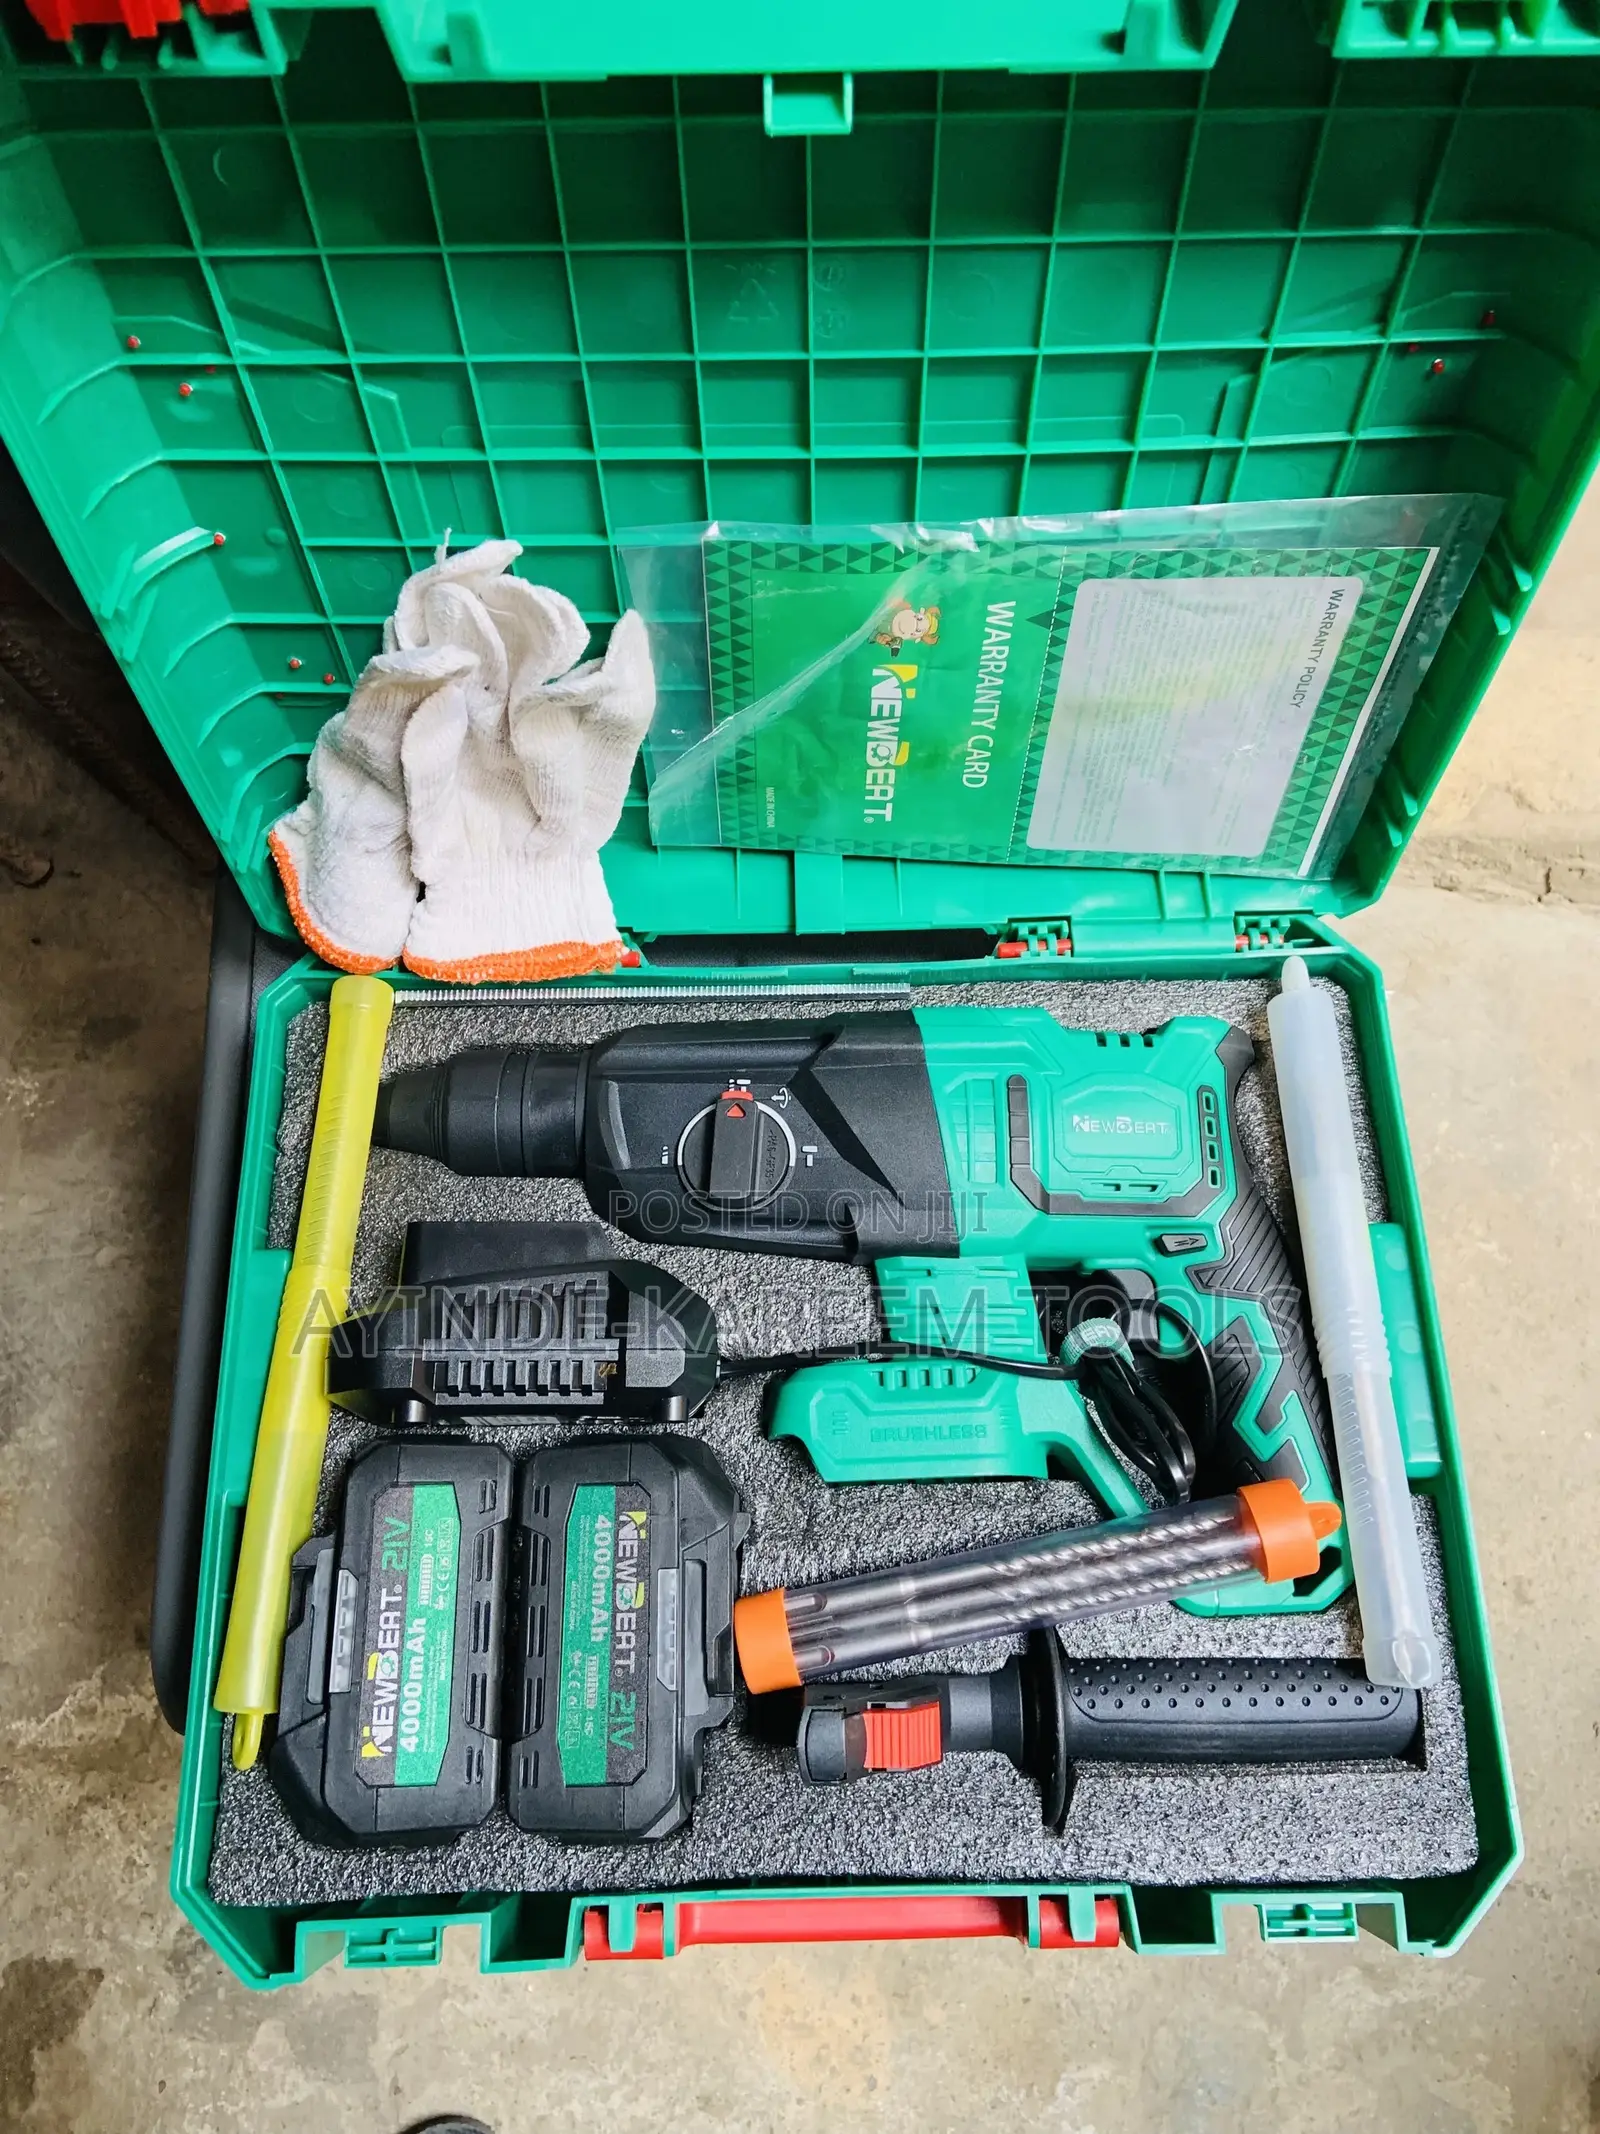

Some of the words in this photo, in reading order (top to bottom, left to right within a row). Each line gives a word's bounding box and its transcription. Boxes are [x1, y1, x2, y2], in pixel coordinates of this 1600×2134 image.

[972, 600, 1017, 730] WARRANTY
[1290, 666, 1316, 710] POLICY
[1306, 588, 1345, 665] WARRANTY
[864, 664, 919, 822] NEWBEAT
[961, 735, 993, 789] CARD
[871, 1424, 987, 1443] BRUSHLESS
[361, 1587, 402, 1758] NEWBEAT
[382, 1516, 409, 1571] 21V
[591, 1514, 612, 1643] 4000mAh
[615, 1511, 647, 1674] NEWBEAT
[399, 1617, 426, 1752] 4000mAh
[608, 1691, 636, 1750] 21V
